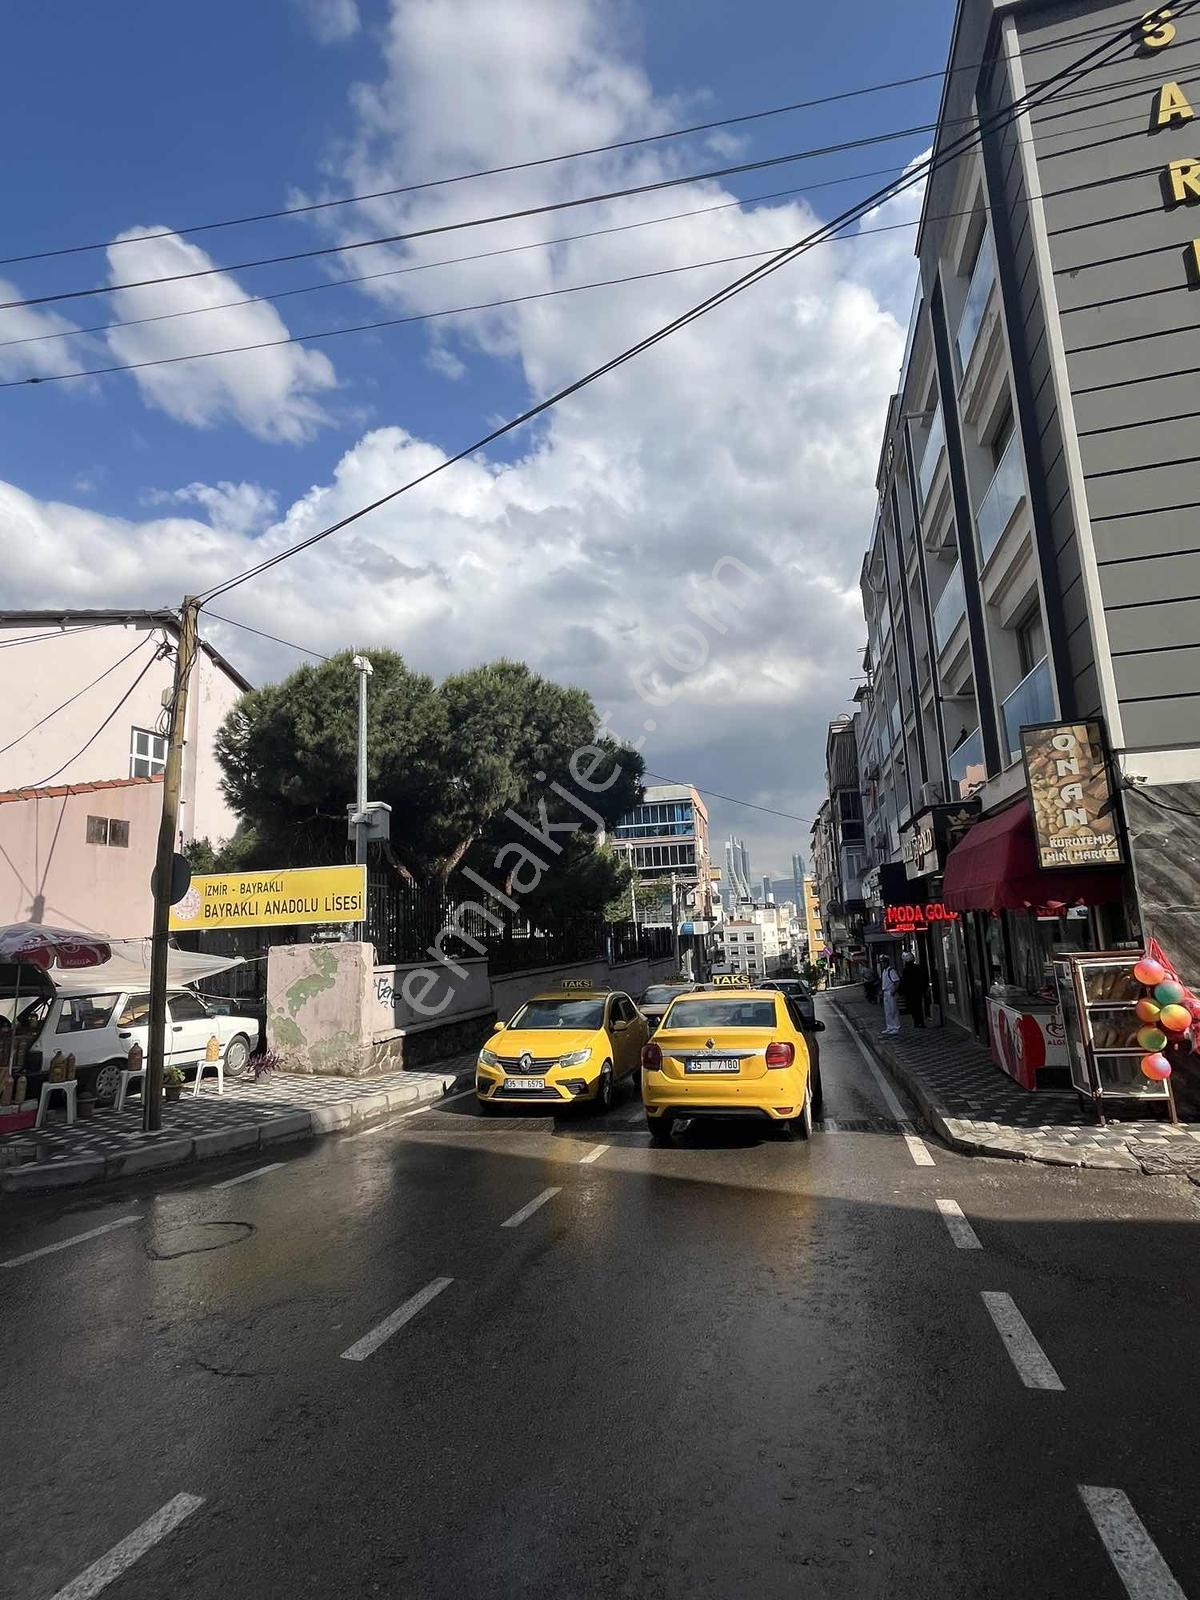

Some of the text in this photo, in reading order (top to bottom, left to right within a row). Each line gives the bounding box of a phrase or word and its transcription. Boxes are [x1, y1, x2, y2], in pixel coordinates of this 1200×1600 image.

[1051, 734, 1088, 826] ONAN
[204, 882, 228, 896] İZMİR
[240, 881, 284, 894] BAYRAKLI
[204, 891, 362, 918] BAYRAKLI ANADOLU LİSESİ
[886, 905, 924, 922] MODA
